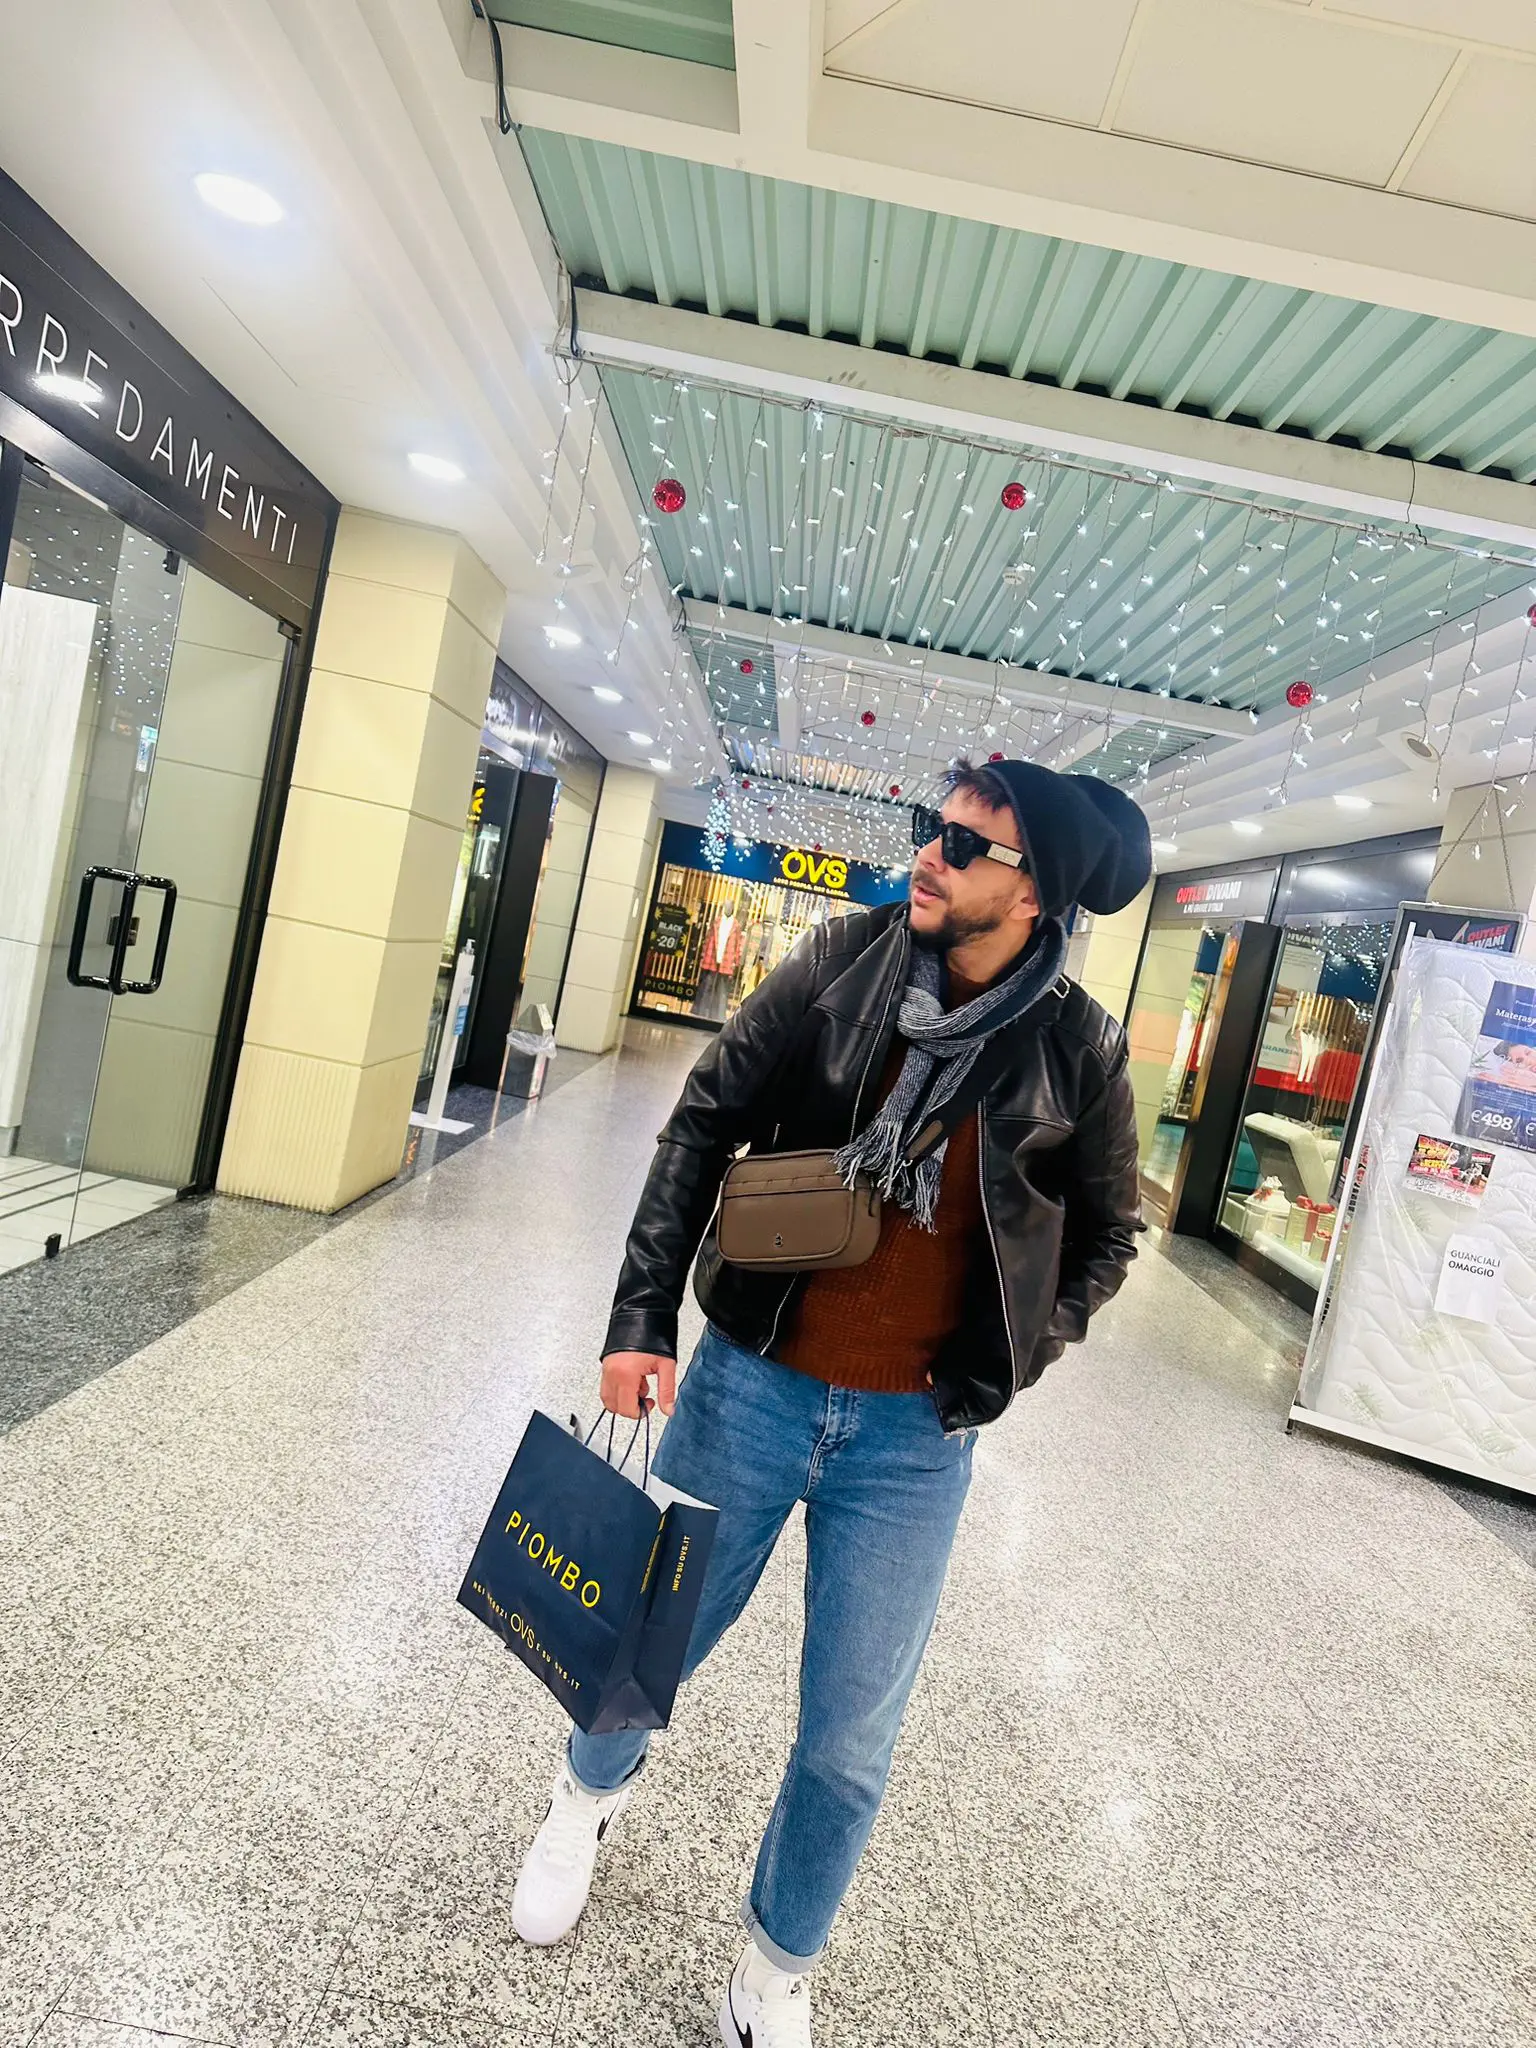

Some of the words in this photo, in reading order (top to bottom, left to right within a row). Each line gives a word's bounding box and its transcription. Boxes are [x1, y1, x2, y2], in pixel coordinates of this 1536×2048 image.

[782, 851, 848, 889] OVS
[658, 921, 684, 933] BLACK
[645, 980, 694, 997] PIOMBO
[1450, 1249, 1501, 1268] GUANCIALI
[1448, 1260, 1495, 1277] OMAGGIO
[504, 1510, 601, 1609] PIOMBO
[510, 1613, 535, 1650] OVS
